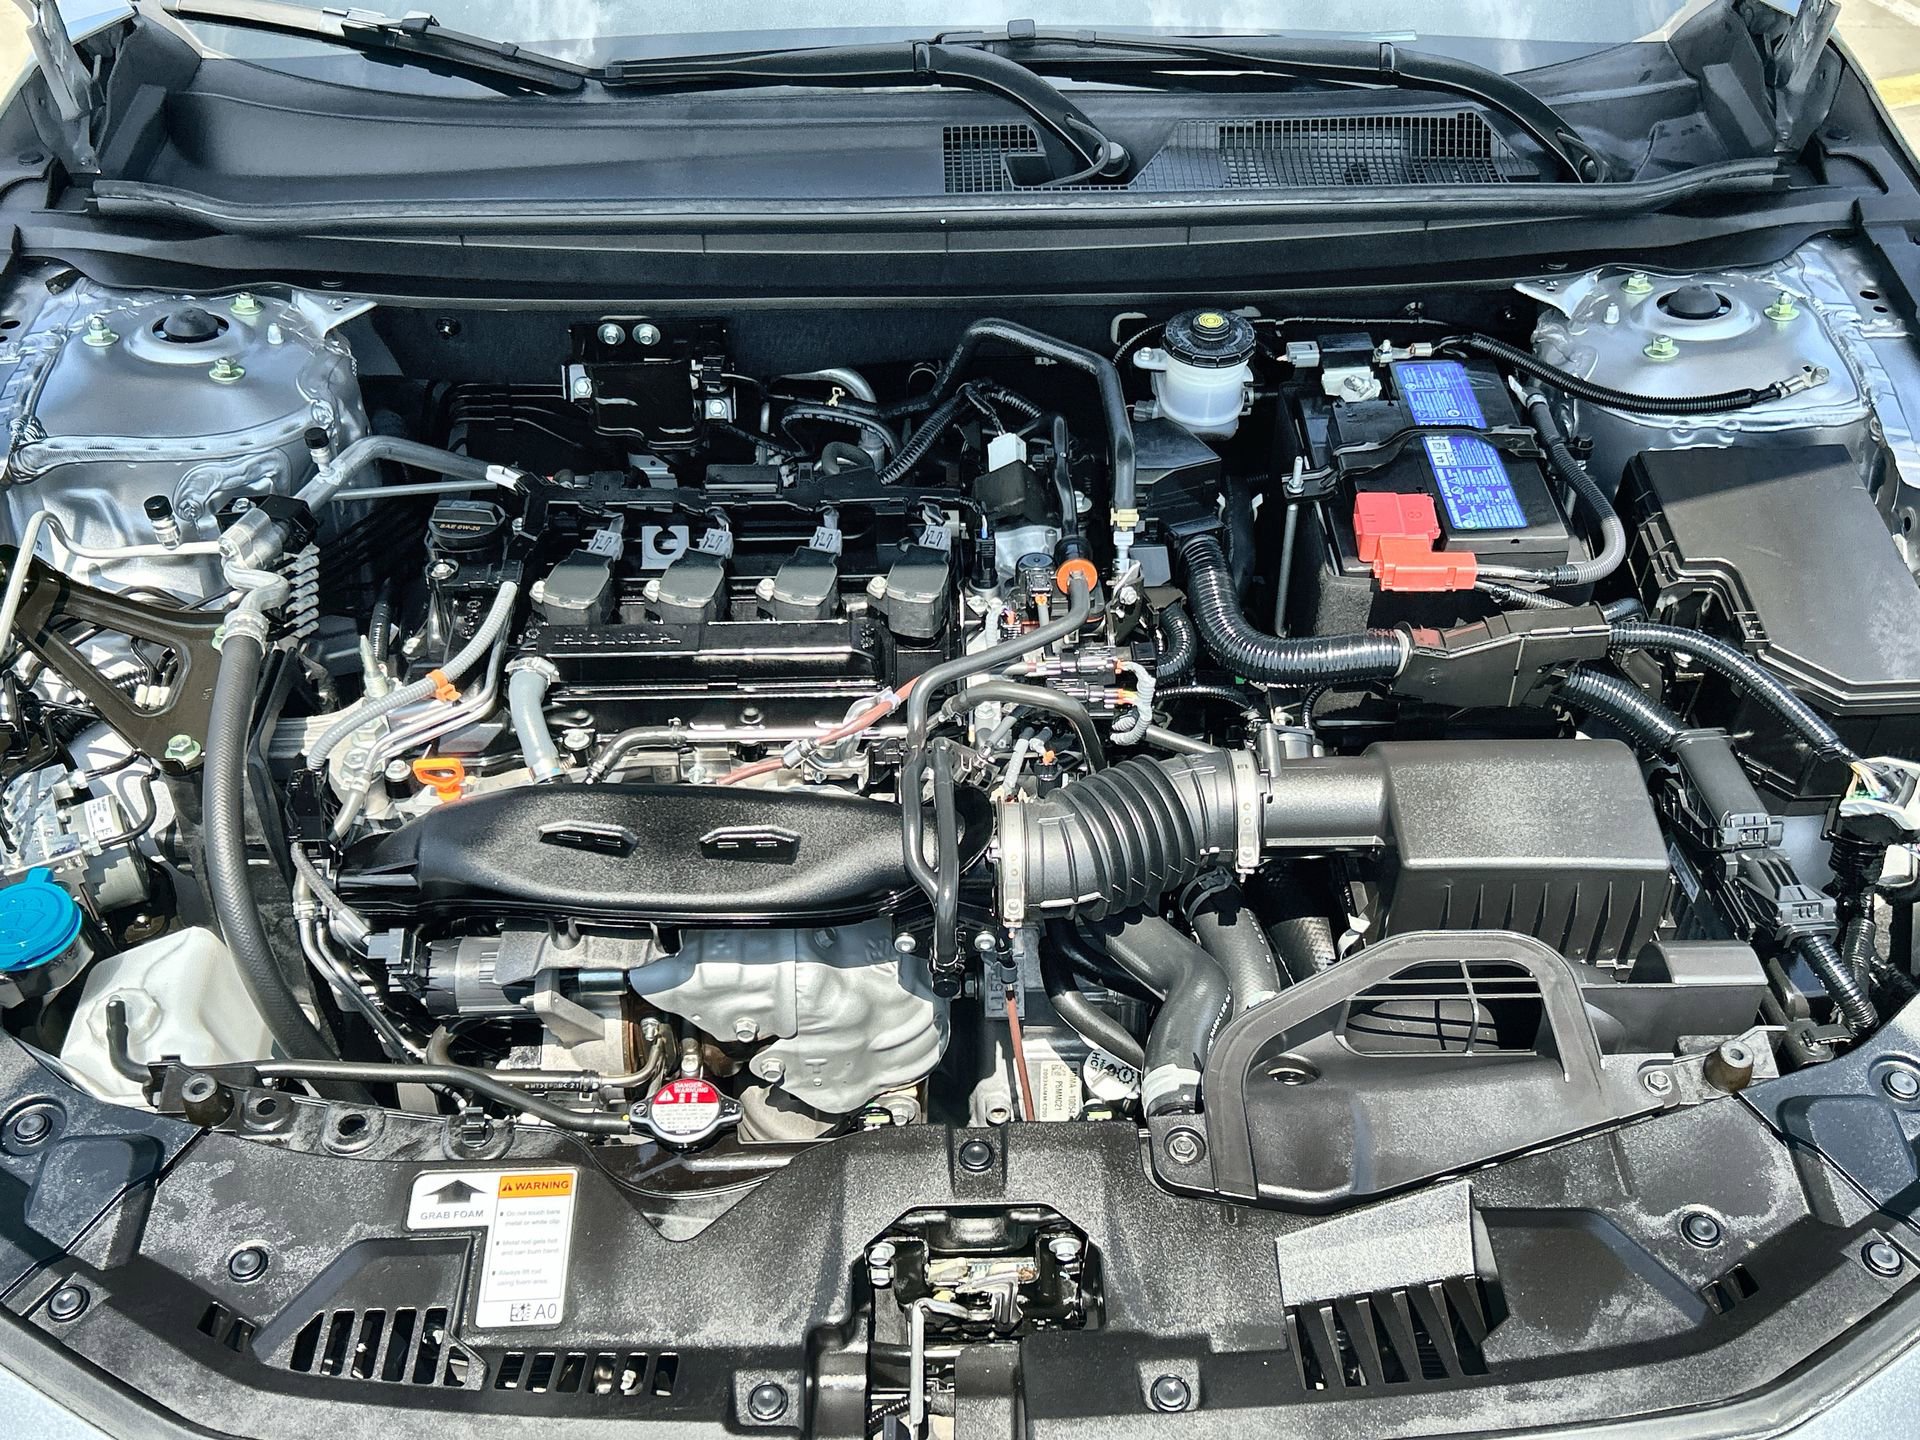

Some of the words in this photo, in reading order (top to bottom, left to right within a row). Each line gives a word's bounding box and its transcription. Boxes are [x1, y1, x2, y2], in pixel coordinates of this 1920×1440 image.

[515, 1180, 569, 1191] WARNING
[420, 1211, 451, 1220] GRAB
[453, 1210, 484, 1219] FOAM
